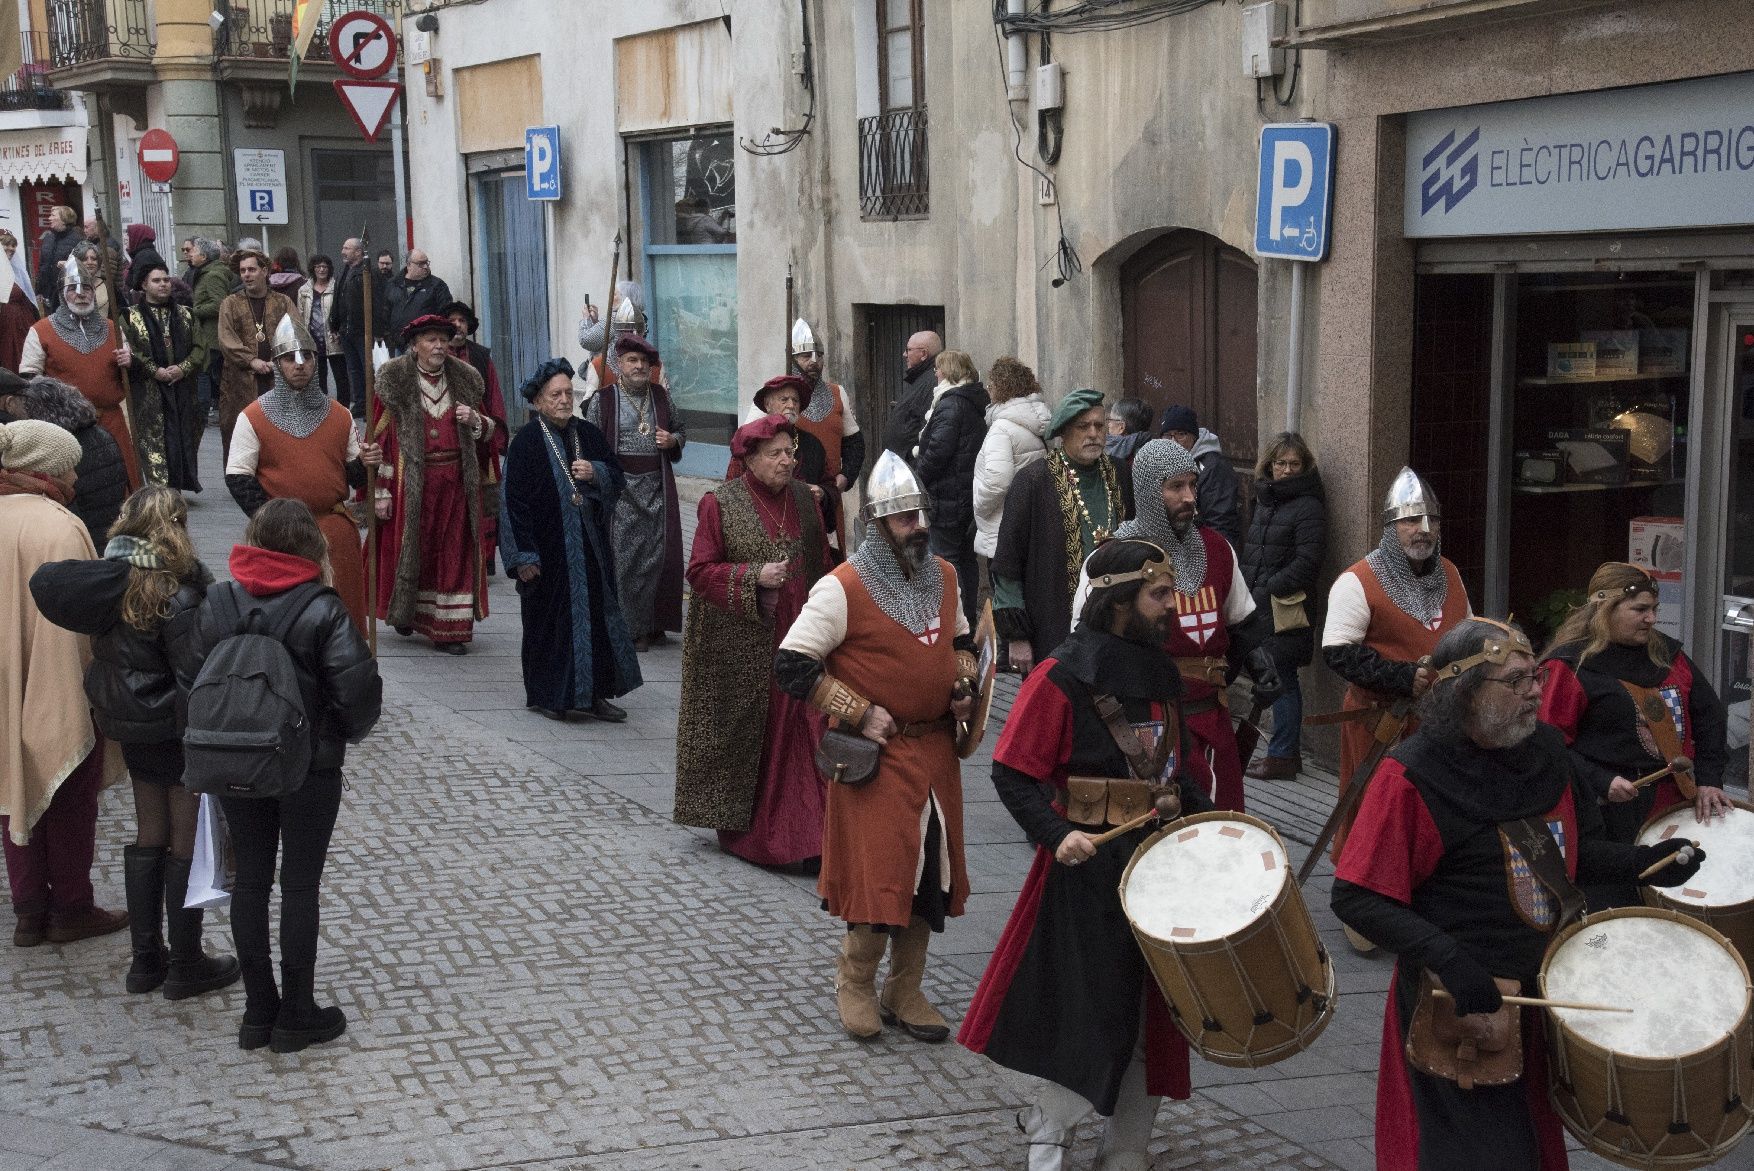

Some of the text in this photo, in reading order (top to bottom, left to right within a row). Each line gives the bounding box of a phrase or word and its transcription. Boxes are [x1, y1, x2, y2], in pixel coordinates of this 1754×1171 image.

[34, 144, 46, 158] DEL
[532, 134, 552, 191] P
[1041, 179, 1052, 199] 14
[1269, 140, 1313, 240] P
[255, 192, 269, 211] P
